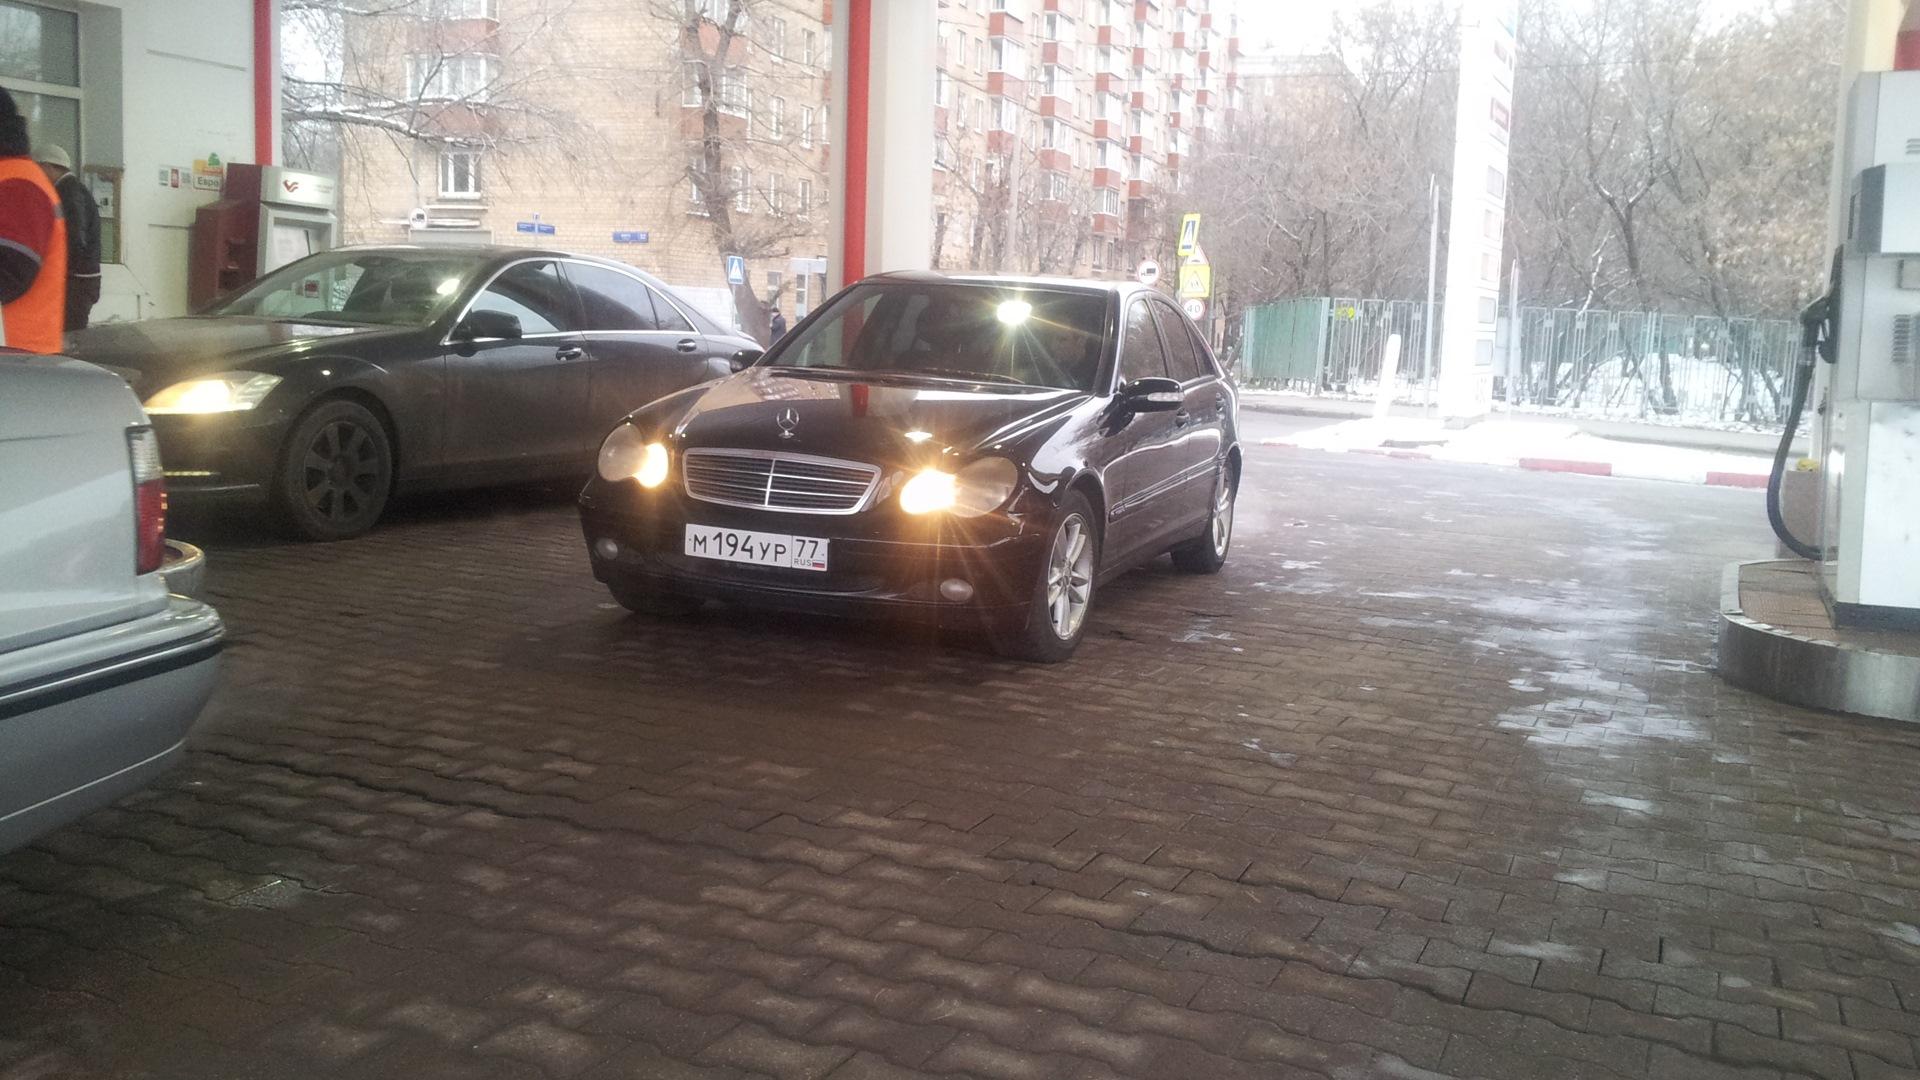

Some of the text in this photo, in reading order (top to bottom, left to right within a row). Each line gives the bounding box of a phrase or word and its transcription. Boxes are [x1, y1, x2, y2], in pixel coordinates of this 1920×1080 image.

[1187, 304, 1201, 313] 40
[795, 539, 819, 559] 77
[794, 558, 812, 567] RUS
